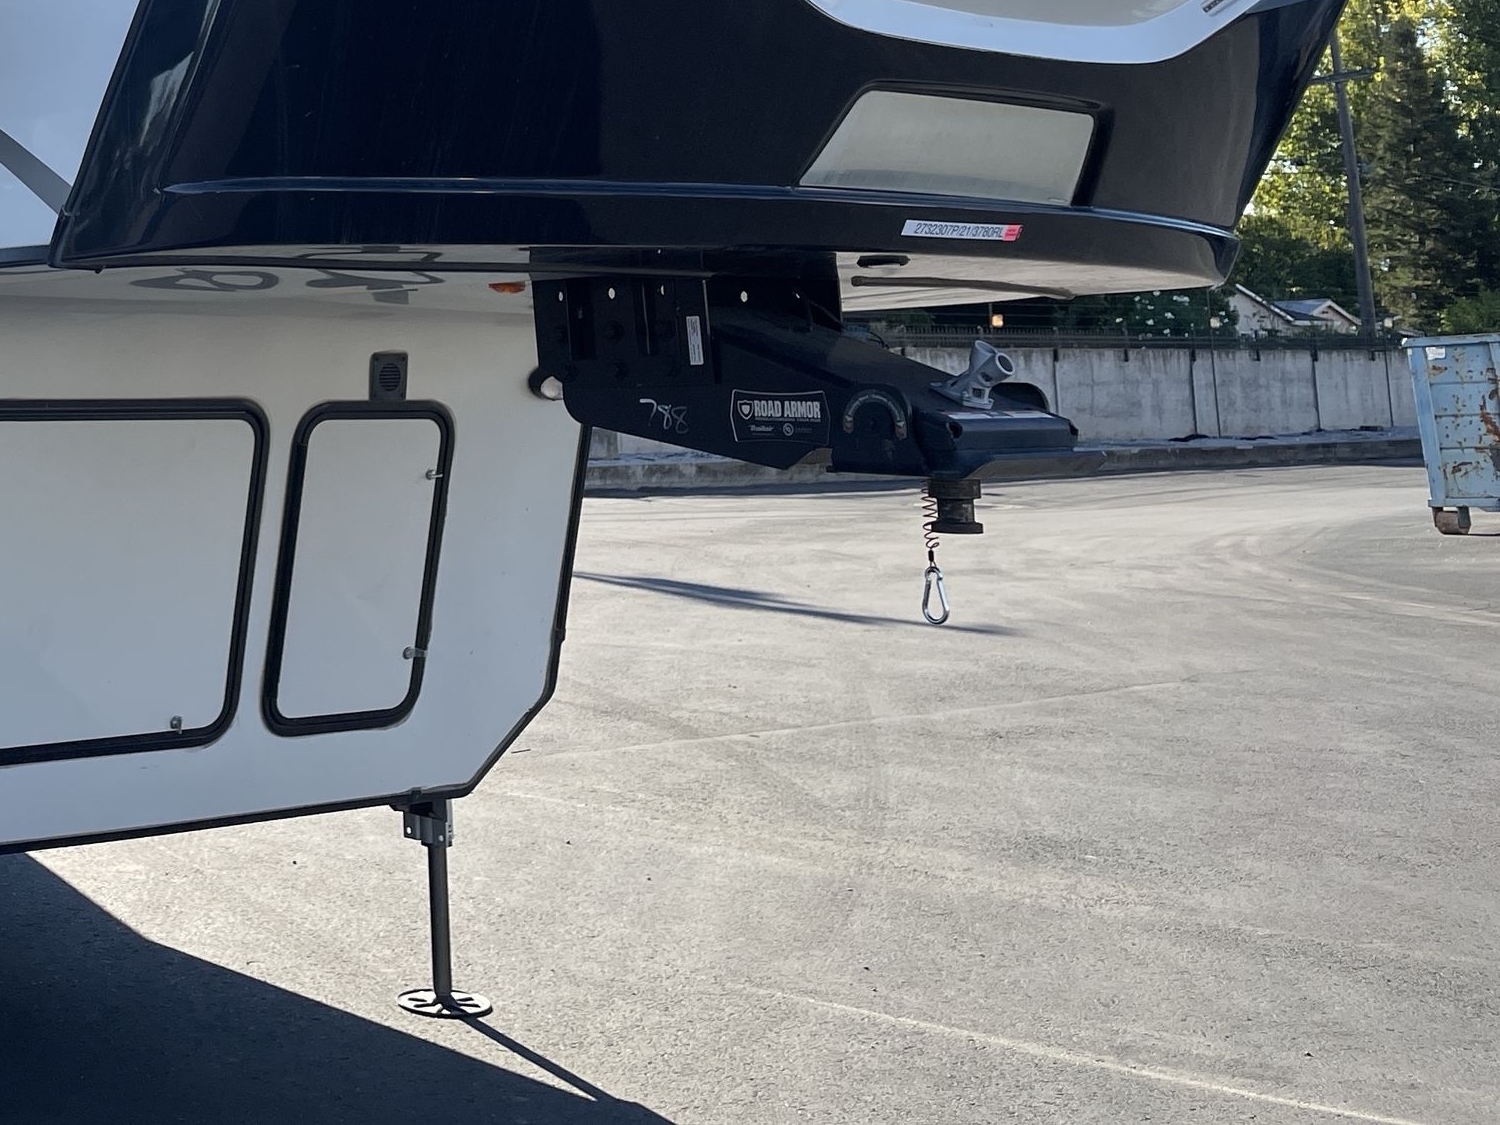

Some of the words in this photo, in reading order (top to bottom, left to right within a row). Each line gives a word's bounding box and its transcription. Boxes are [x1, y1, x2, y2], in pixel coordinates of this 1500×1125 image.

[639, 398, 690, 434] 788
[753, 400, 782, 417] ROAD
[784, 401, 821, 418] ARMOR
